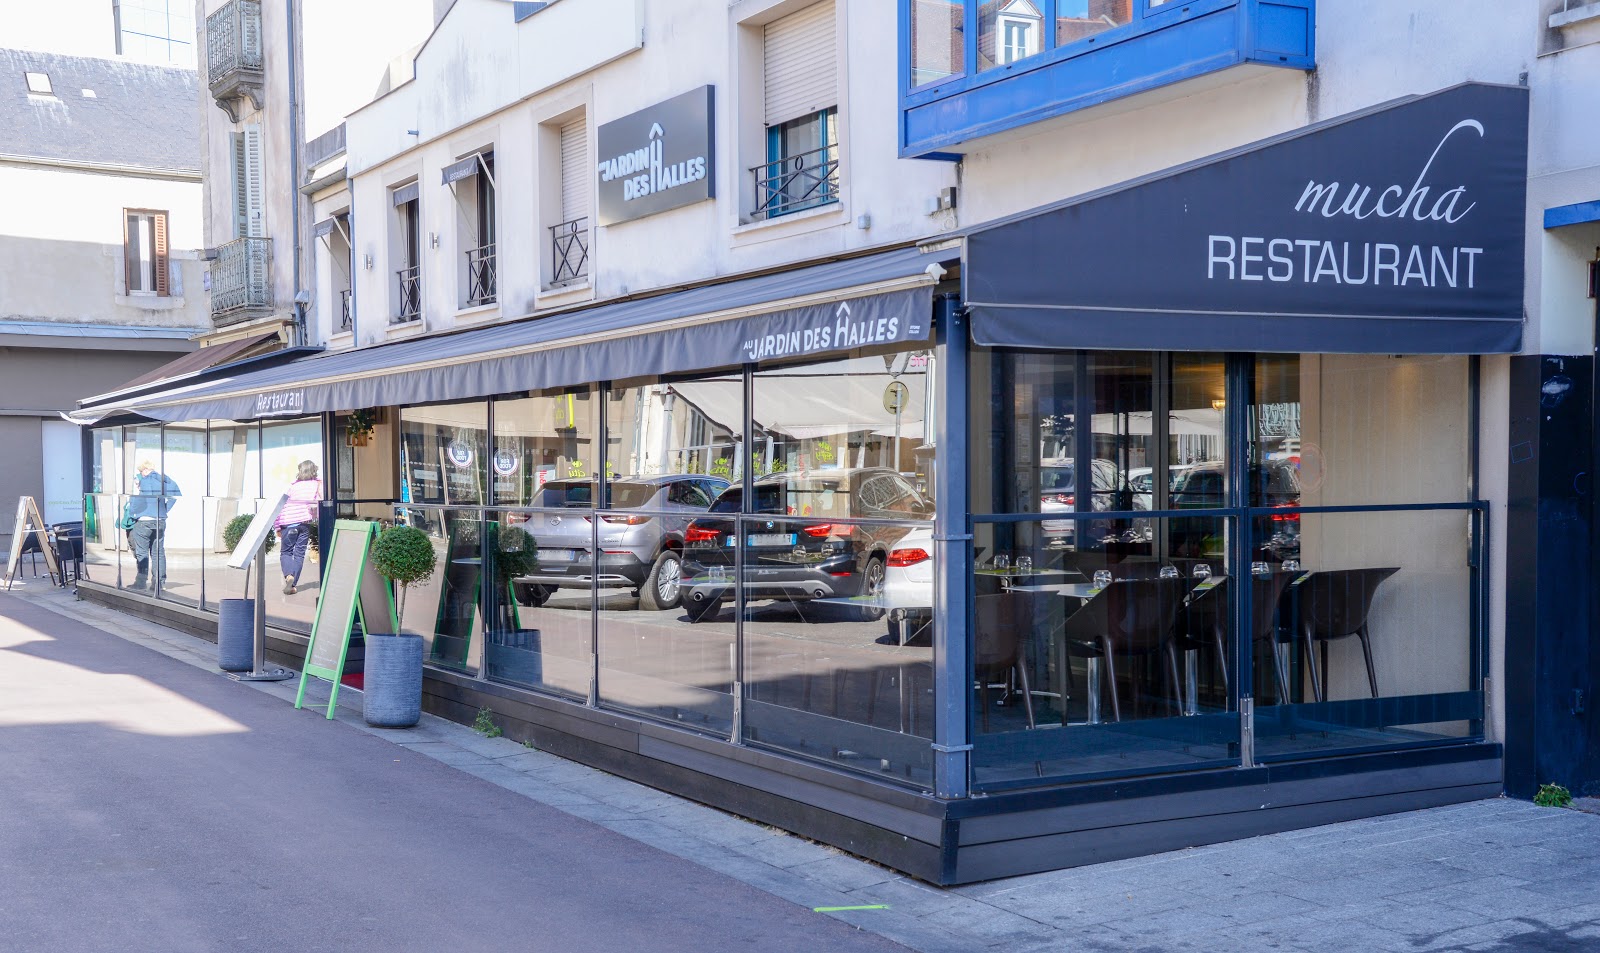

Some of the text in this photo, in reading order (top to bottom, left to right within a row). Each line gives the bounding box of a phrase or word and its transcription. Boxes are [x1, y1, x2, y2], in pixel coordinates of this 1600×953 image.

[602, 147, 649, 182] JARDIN
[1295, 119, 1484, 223] mucha
[624, 174, 649, 201] DES
[1207, 235, 1483, 289] RESTAURANT
[743, 340, 753, 350] AU
[749, 330, 800, 359] JARDIN
[803, 326, 830, 351] DES
[257, 389, 303, 411] Restaurant
